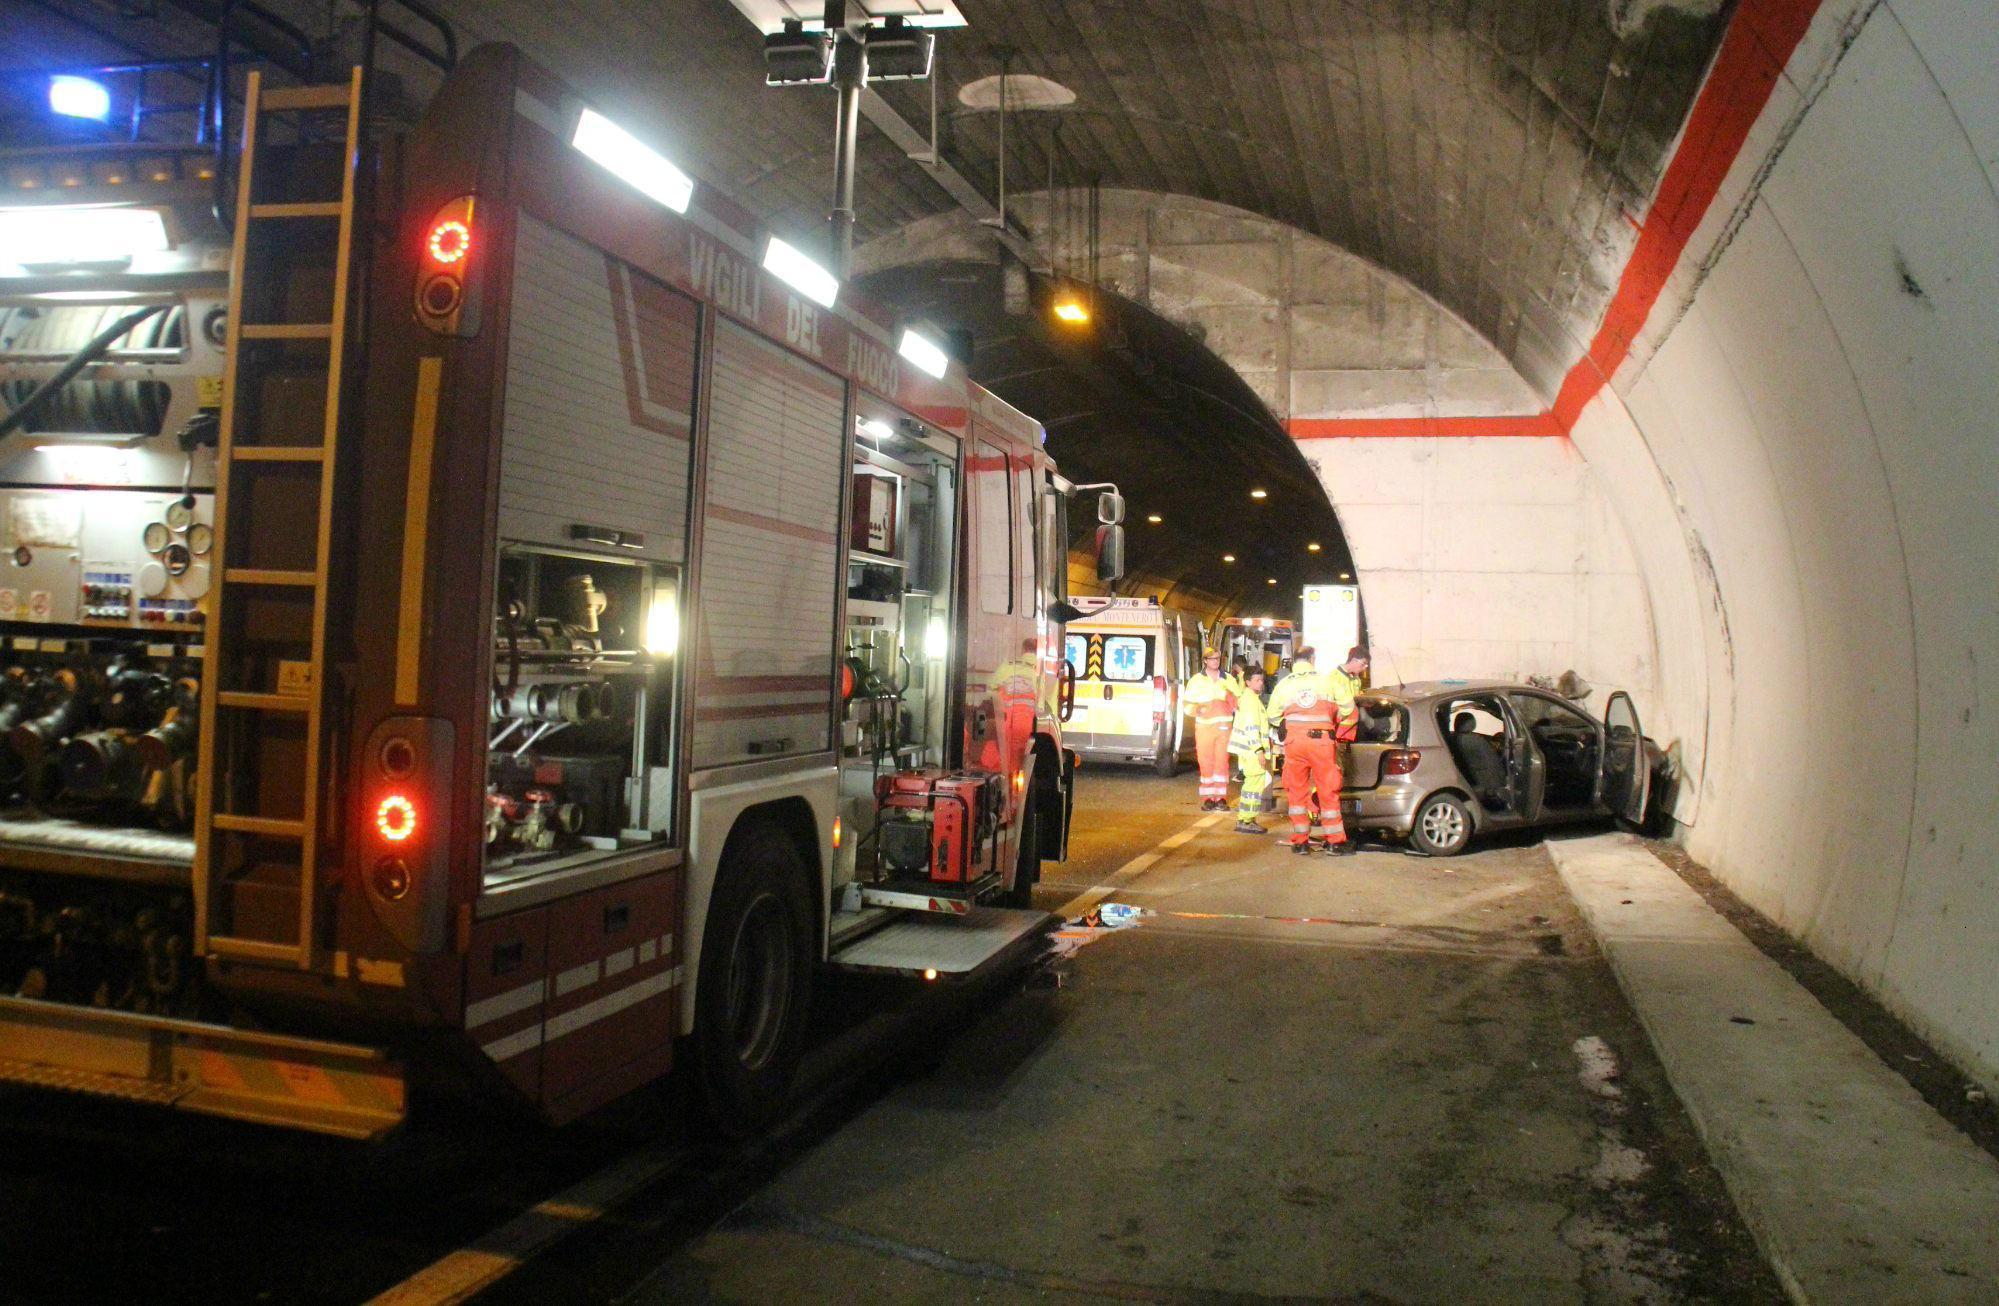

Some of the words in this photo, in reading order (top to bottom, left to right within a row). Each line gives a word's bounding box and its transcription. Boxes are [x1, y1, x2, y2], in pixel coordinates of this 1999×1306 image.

[690, 232, 762, 324] VIGILI
[786, 294, 822, 358] DEL
[848, 331, 898, 398] FUOCO
[1103, 611, 1153, 623] MONTENERO
